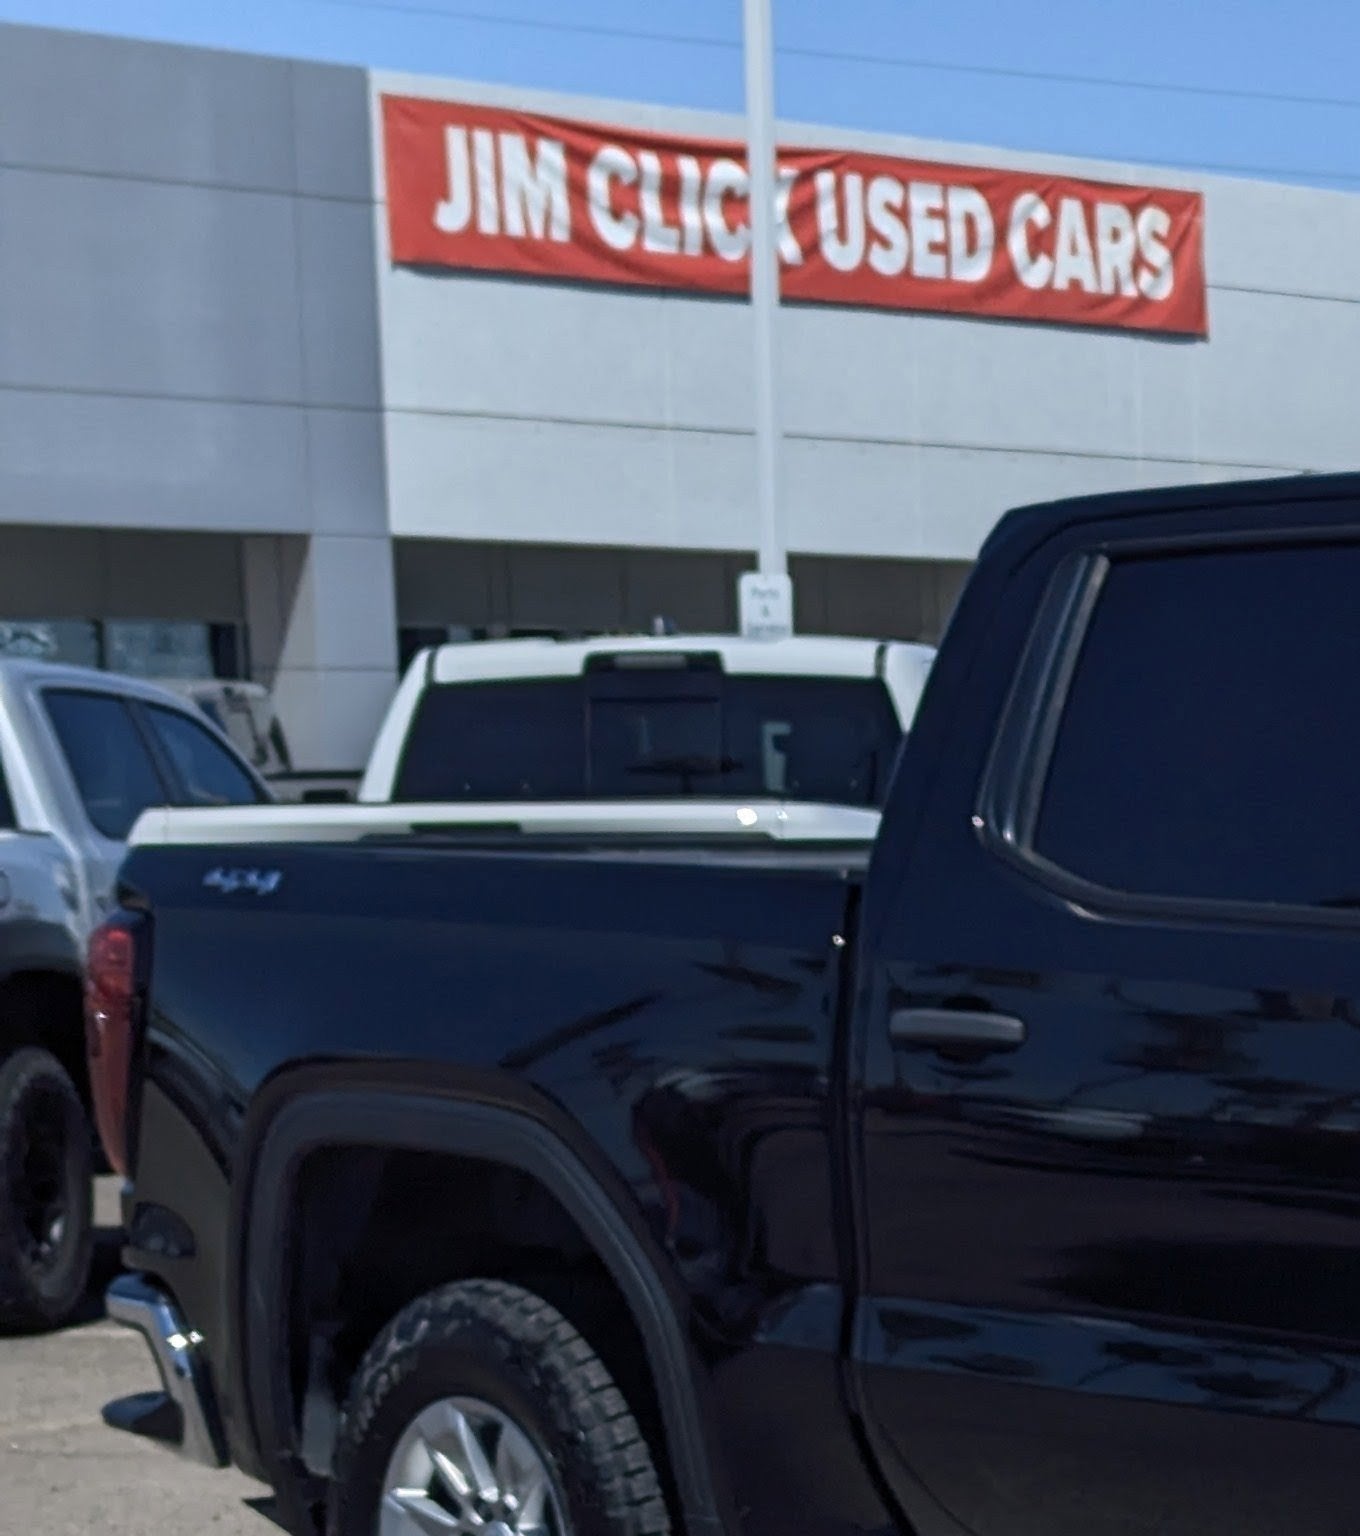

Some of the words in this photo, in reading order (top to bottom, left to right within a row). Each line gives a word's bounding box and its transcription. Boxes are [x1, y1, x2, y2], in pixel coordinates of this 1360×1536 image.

[434, 126, 568, 242] JIM
[814, 170, 994, 282] USED
[1008, 193, 1174, 300] CARS
